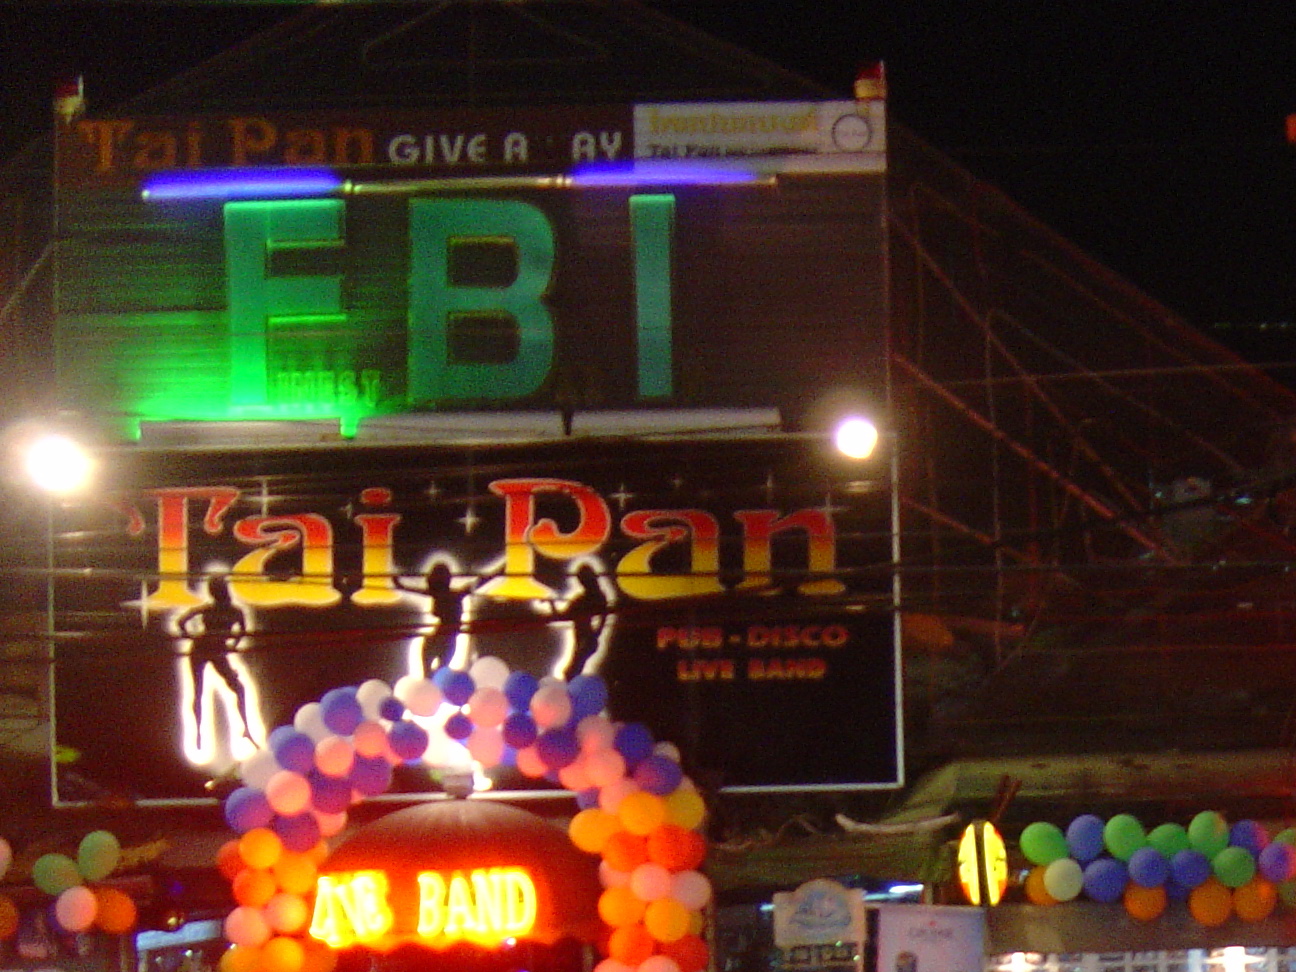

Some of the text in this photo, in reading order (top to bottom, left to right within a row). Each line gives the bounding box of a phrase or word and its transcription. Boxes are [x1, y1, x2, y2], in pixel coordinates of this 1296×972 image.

[77, 117, 201, 172] Tai
[229, 115, 374, 167] Pan
[388, 132, 487, 165] GIVE
[104, 476, 847, 609] Tai Pan
[656, 626, 725, 649] PUB
[747, 624, 850, 648] DISCO
[676, 658, 827, 682] LIVE BAND
[416, 866, 537, 940] BAND
